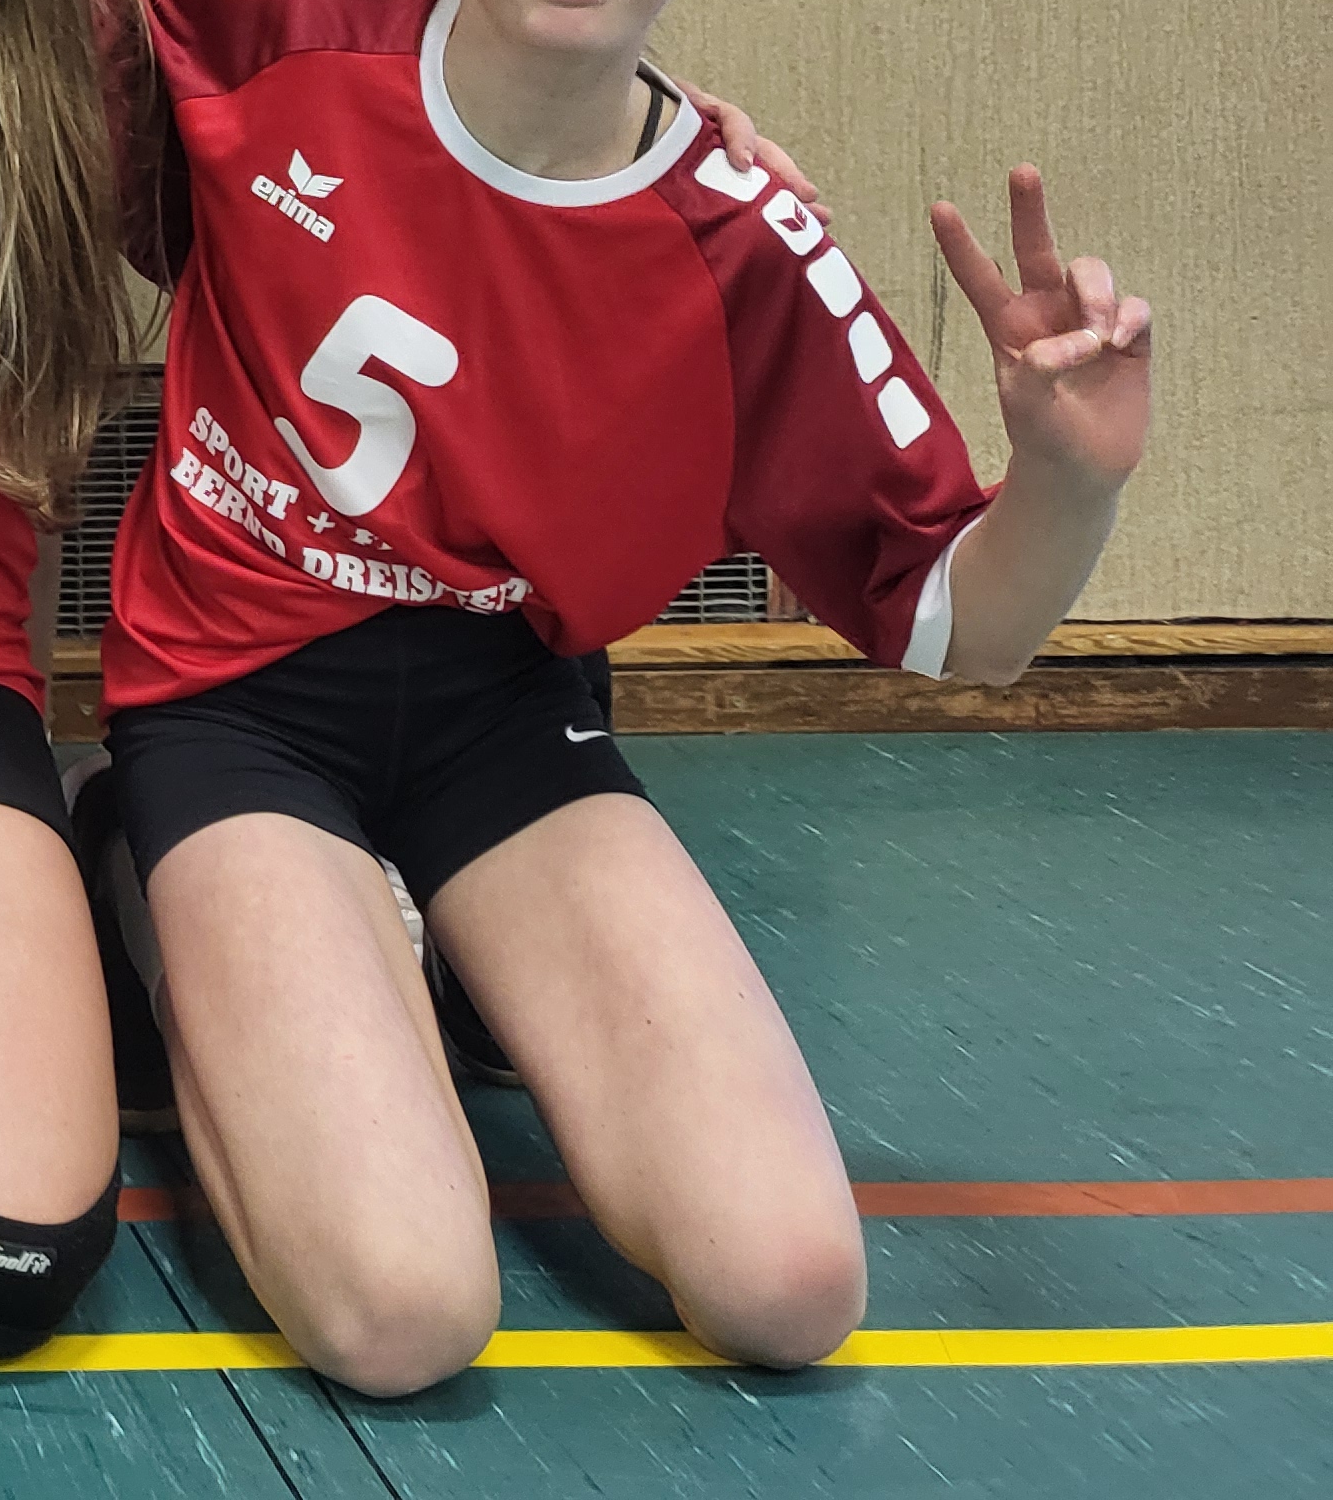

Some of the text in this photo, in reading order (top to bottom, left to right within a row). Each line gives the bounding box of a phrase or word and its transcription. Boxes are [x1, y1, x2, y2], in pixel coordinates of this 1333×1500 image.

[250, 174, 336, 243] erima
[189, 406, 299, 520] SPORT
[274, 295, 458, 517] 5
